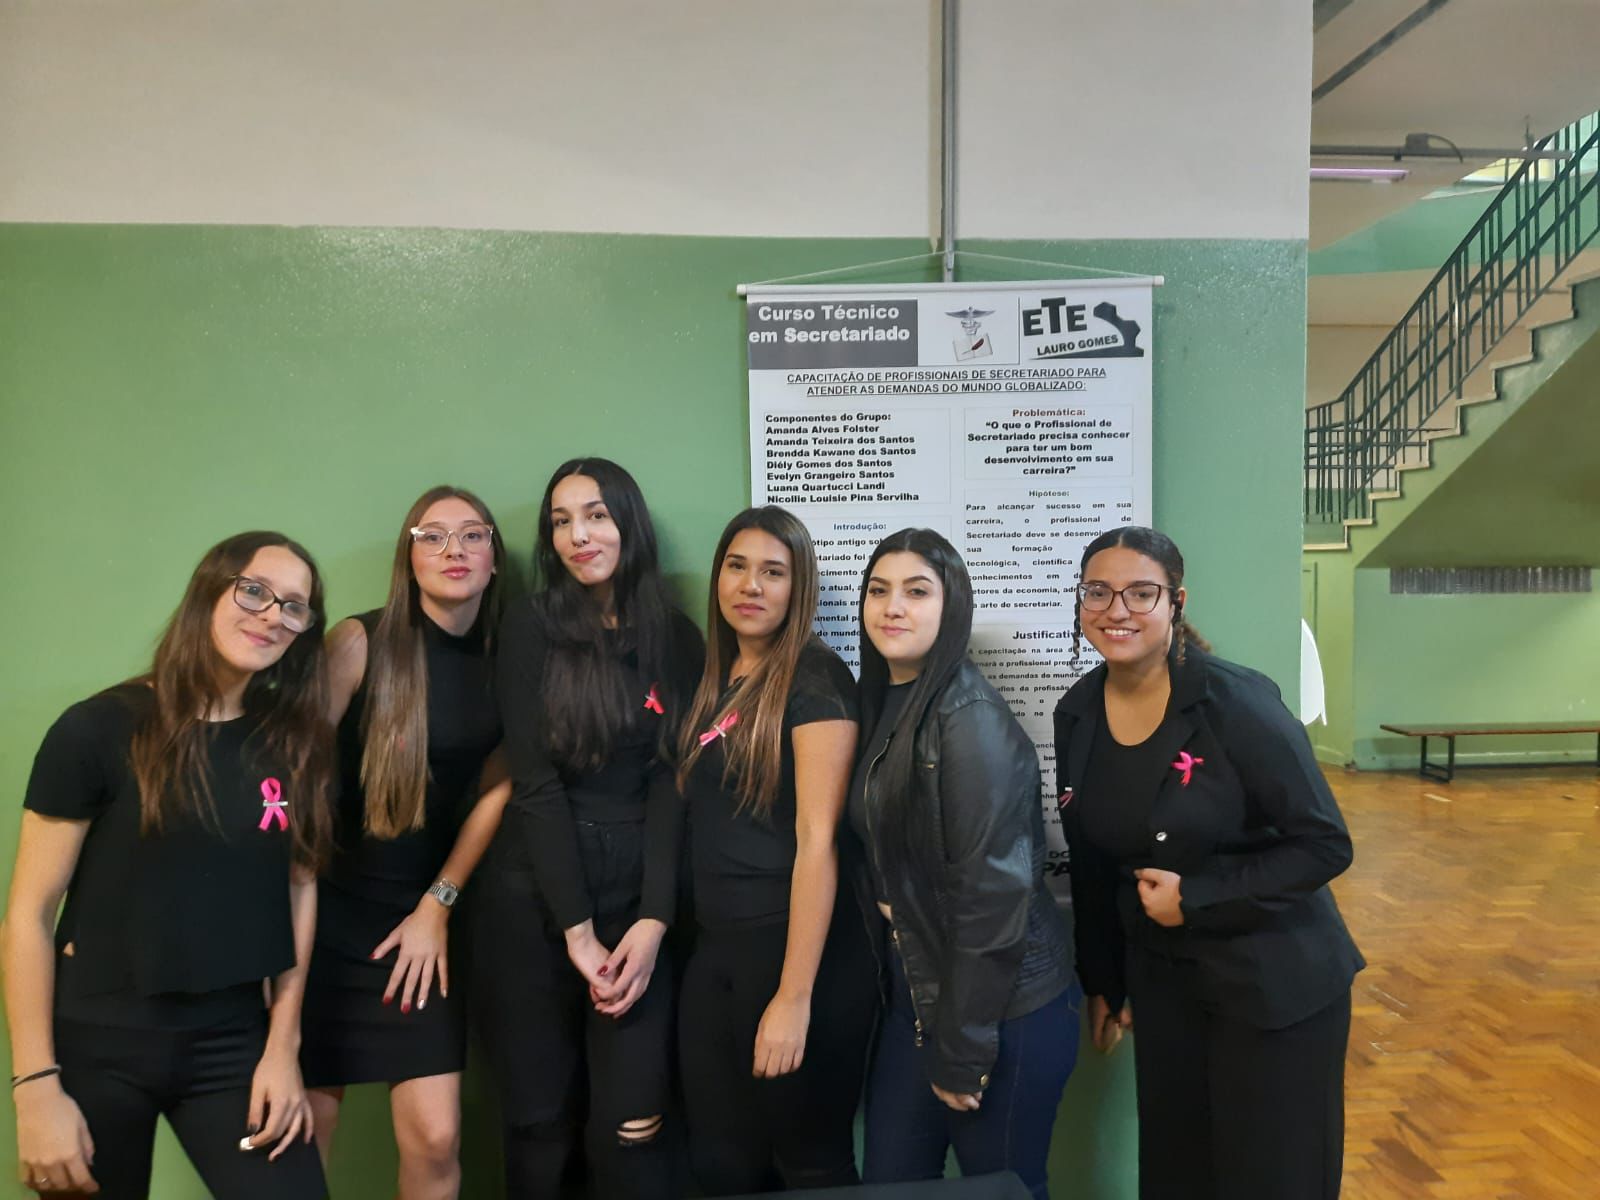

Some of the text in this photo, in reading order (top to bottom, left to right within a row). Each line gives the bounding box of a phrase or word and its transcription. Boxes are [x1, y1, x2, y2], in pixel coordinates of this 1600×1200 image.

[758, 305, 899, 321] Curso Técnico
[1023, 297, 1087, 336] ETE
[749, 325, 911, 343] em Secretariado
[1037, 334, 1118, 356] LAURO GOMES
[787, 367, 1107, 383] CAPACITAÇÃO DE PROFISSIONAIS DE SECRETARIADO PARA
[807, 380, 1087, 396] ATENDER AS DEMANDAS DO MUNDO GLOBALIZADO:
[1012, 408, 1086, 417] Problemática:
[765, 413, 891, 424] Componentes do Grupo:
[766, 424, 879, 434] Amanda Alves Folster
[1002, 422, 1021, 431] que
[1034, 420, 1096, 428] Profissional
[766, 436, 915, 446] Amanda Teixeira dos Santos
[967, 431, 1130, 442] Secretariado precisa conhecer
[766, 447, 916, 458] Brendda Kawane dos Santos
[1006, 445, 1029, 453] para
[796, 461, 831, 469] Gomes
[835, 460, 853, 468] dos
[857, 459, 892, 467] Santos
[984, 455, 1073, 464] desenvolvimento
[767, 471, 895, 482] Evelyn Grangeiro Santos
[767, 482, 885, 492] Luana Quartucci Landi
[810, 494, 847, 502] Louisie
[851, 494, 873, 502] Pina
[877, 493, 919, 501] Servilha
[1029, 490, 1070, 498] Hipótese:
[997, 504, 1035, 512] alcançar
[1050, 516, 1100, 525] profissional
[833, 523, 886, 531] Introdução:
[837, 538, 866, 546] antigo
[1012, 545, 1053, 553] formação
[967, 559, 1020, 567] tecnológica,
[1016, 586, 1060, 594] economia,
